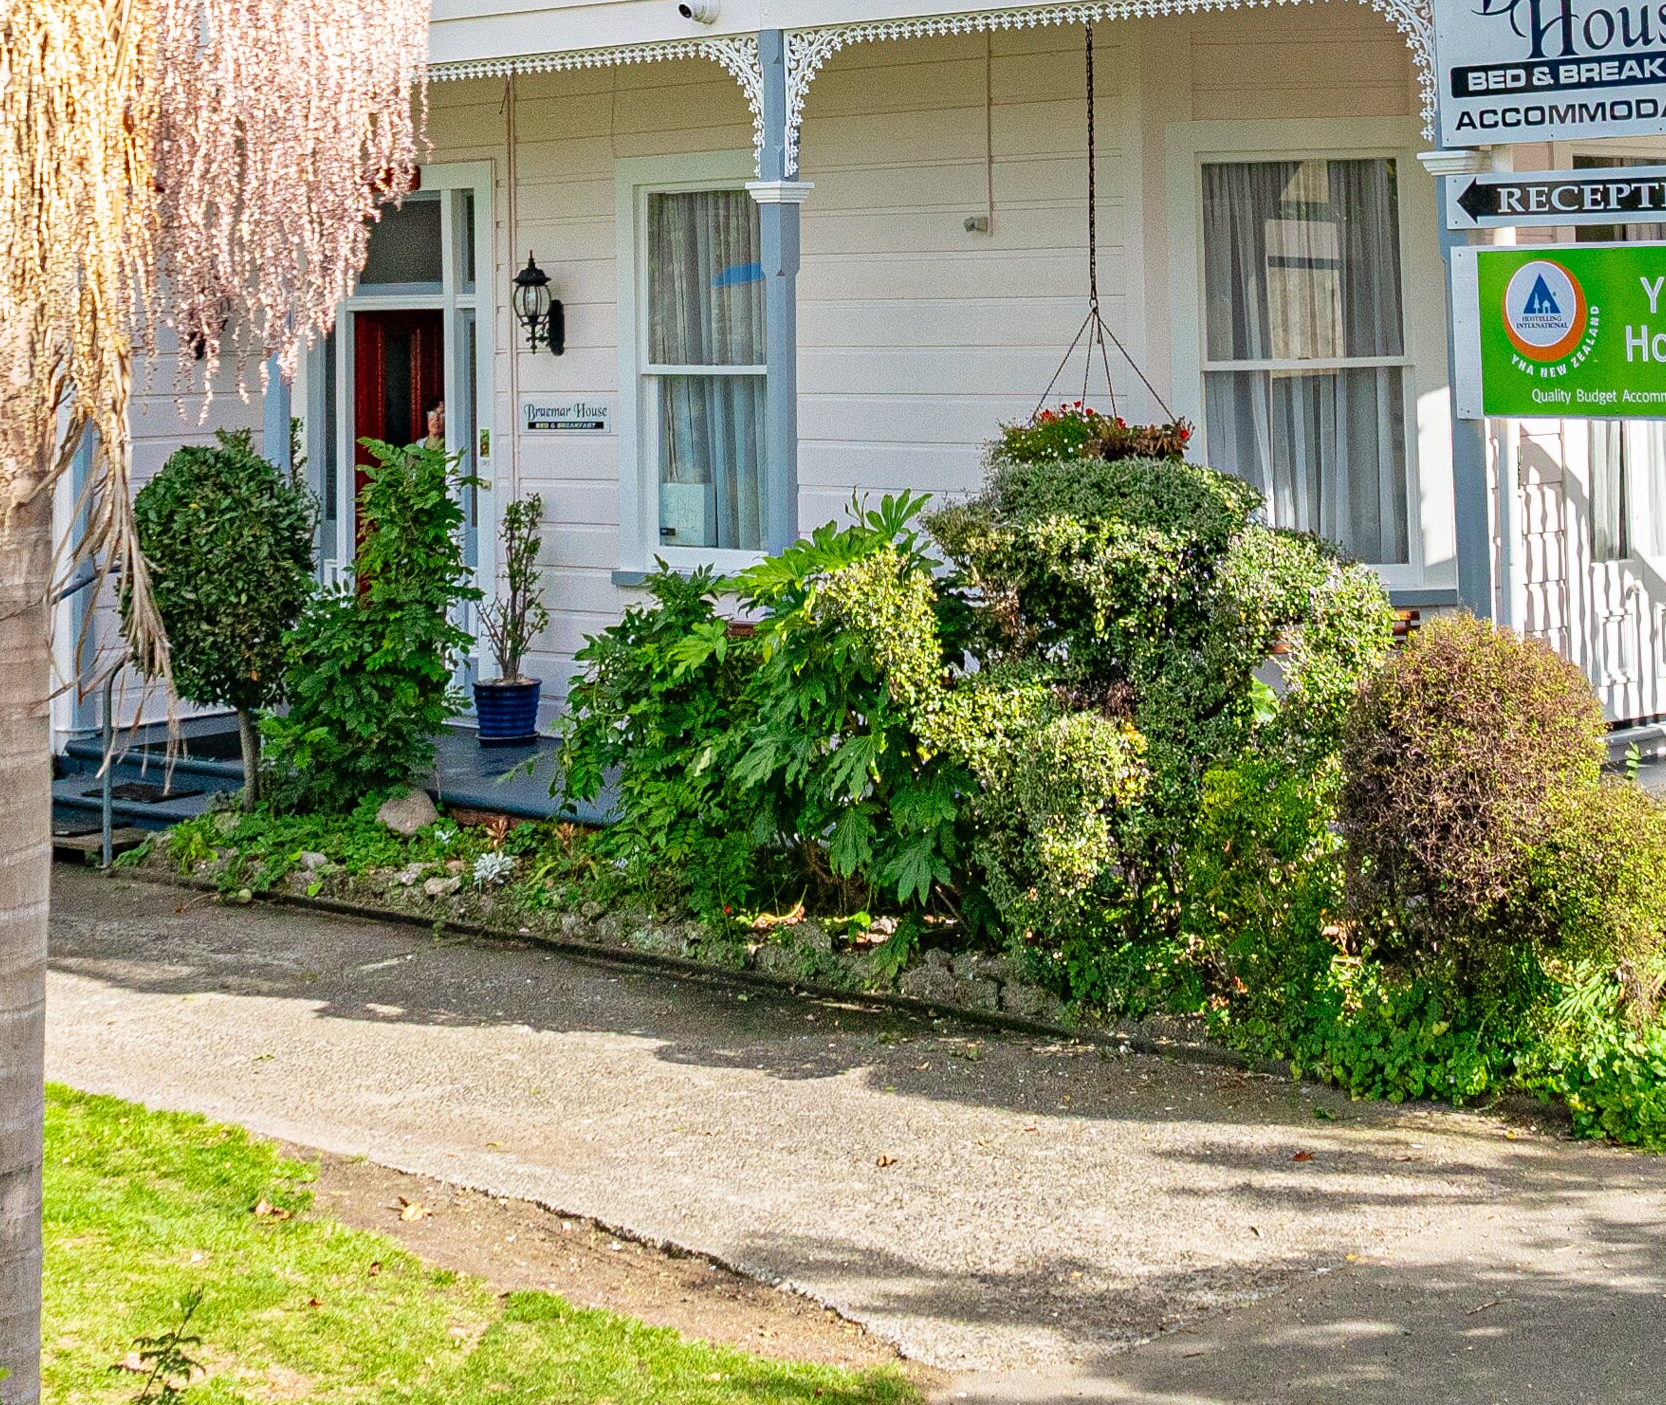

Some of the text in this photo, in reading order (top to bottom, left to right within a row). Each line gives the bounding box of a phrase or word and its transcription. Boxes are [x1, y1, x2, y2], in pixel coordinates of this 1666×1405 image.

[1467, 67, 1526, 92] BED
[1532, 66, 1554, 86] &
[1511, 306, 1600, 378] YHA NEW ZEALAND
[1532, 388, 1571, 405] Quality
[1576, 388, 1617, 405] Budget
[523, 403, 608, 421] Braemar House
